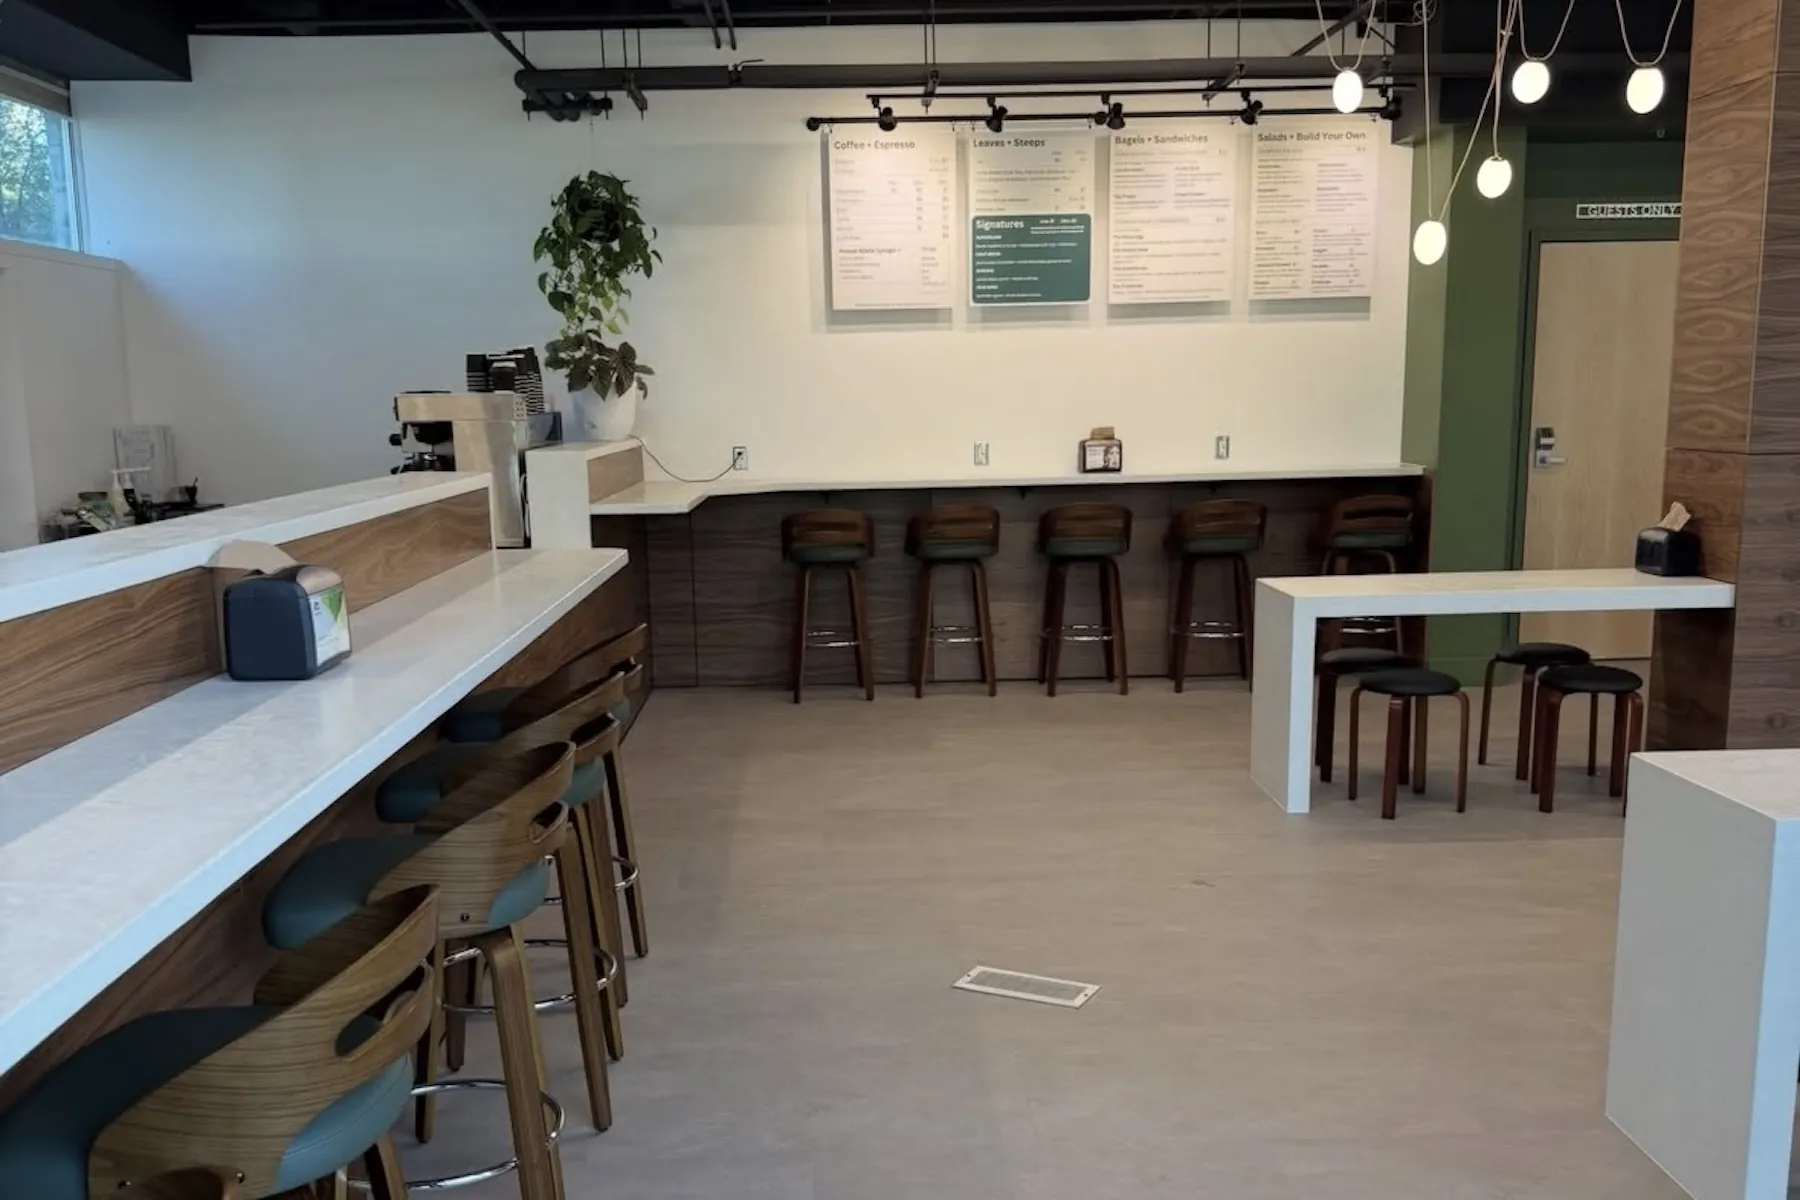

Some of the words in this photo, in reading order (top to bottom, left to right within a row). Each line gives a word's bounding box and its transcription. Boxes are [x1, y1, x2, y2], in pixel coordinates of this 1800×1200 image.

[1115, 134, 1145, 146] Bagels
[1153, 132, 1209, 144] Sandwiches
[1257, 131, 1288, 141] Salads
[1296, 131, 1320, 141] Build
[1321, 130, 1344, 140] Your
[1345, 130, 1366, 140] Own
[833, 140, 866, 150] Coffee
[873, 139, 916, 150] Espresso
[973, 138, 1005, 148] Leaves
[1013, 138, 1046, 149] Steeps
[1588, 205, 1638, 216] GUESTS
[1642, 204, 1677, 215] ONLY
[975, 219, 1025, 231] Signatures
